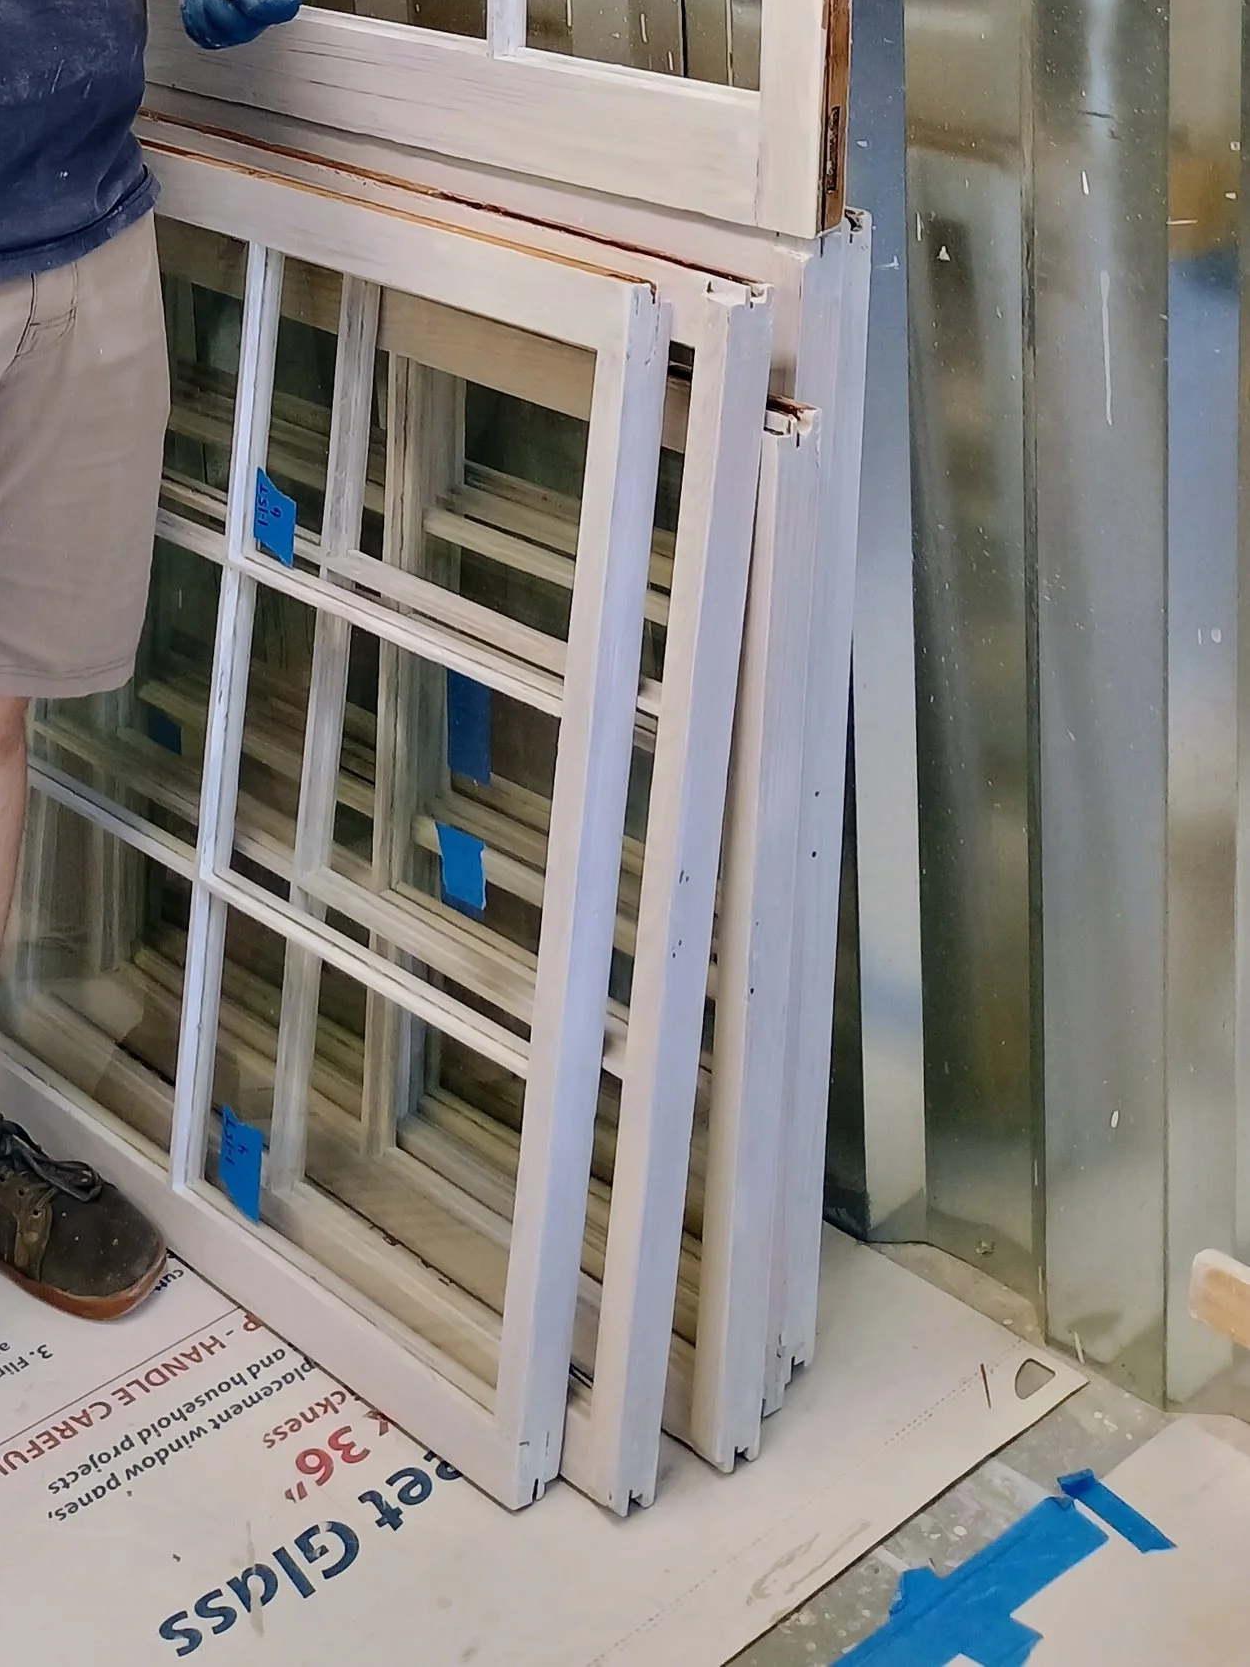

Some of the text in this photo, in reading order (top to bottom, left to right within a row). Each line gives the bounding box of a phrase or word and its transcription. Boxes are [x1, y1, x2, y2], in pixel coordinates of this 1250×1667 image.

[30, 1345, 53, 1359] 3.
[111, 1336, 226, 1406] HANDLE
[247, 1349, 285, 1379] and
[49, 1435, 135, 1494] projects
[126, 1427, 207, 1480] window
[48, 1473, 121, 1520] panes,
[159, 1521, 359, 1656] Glass
